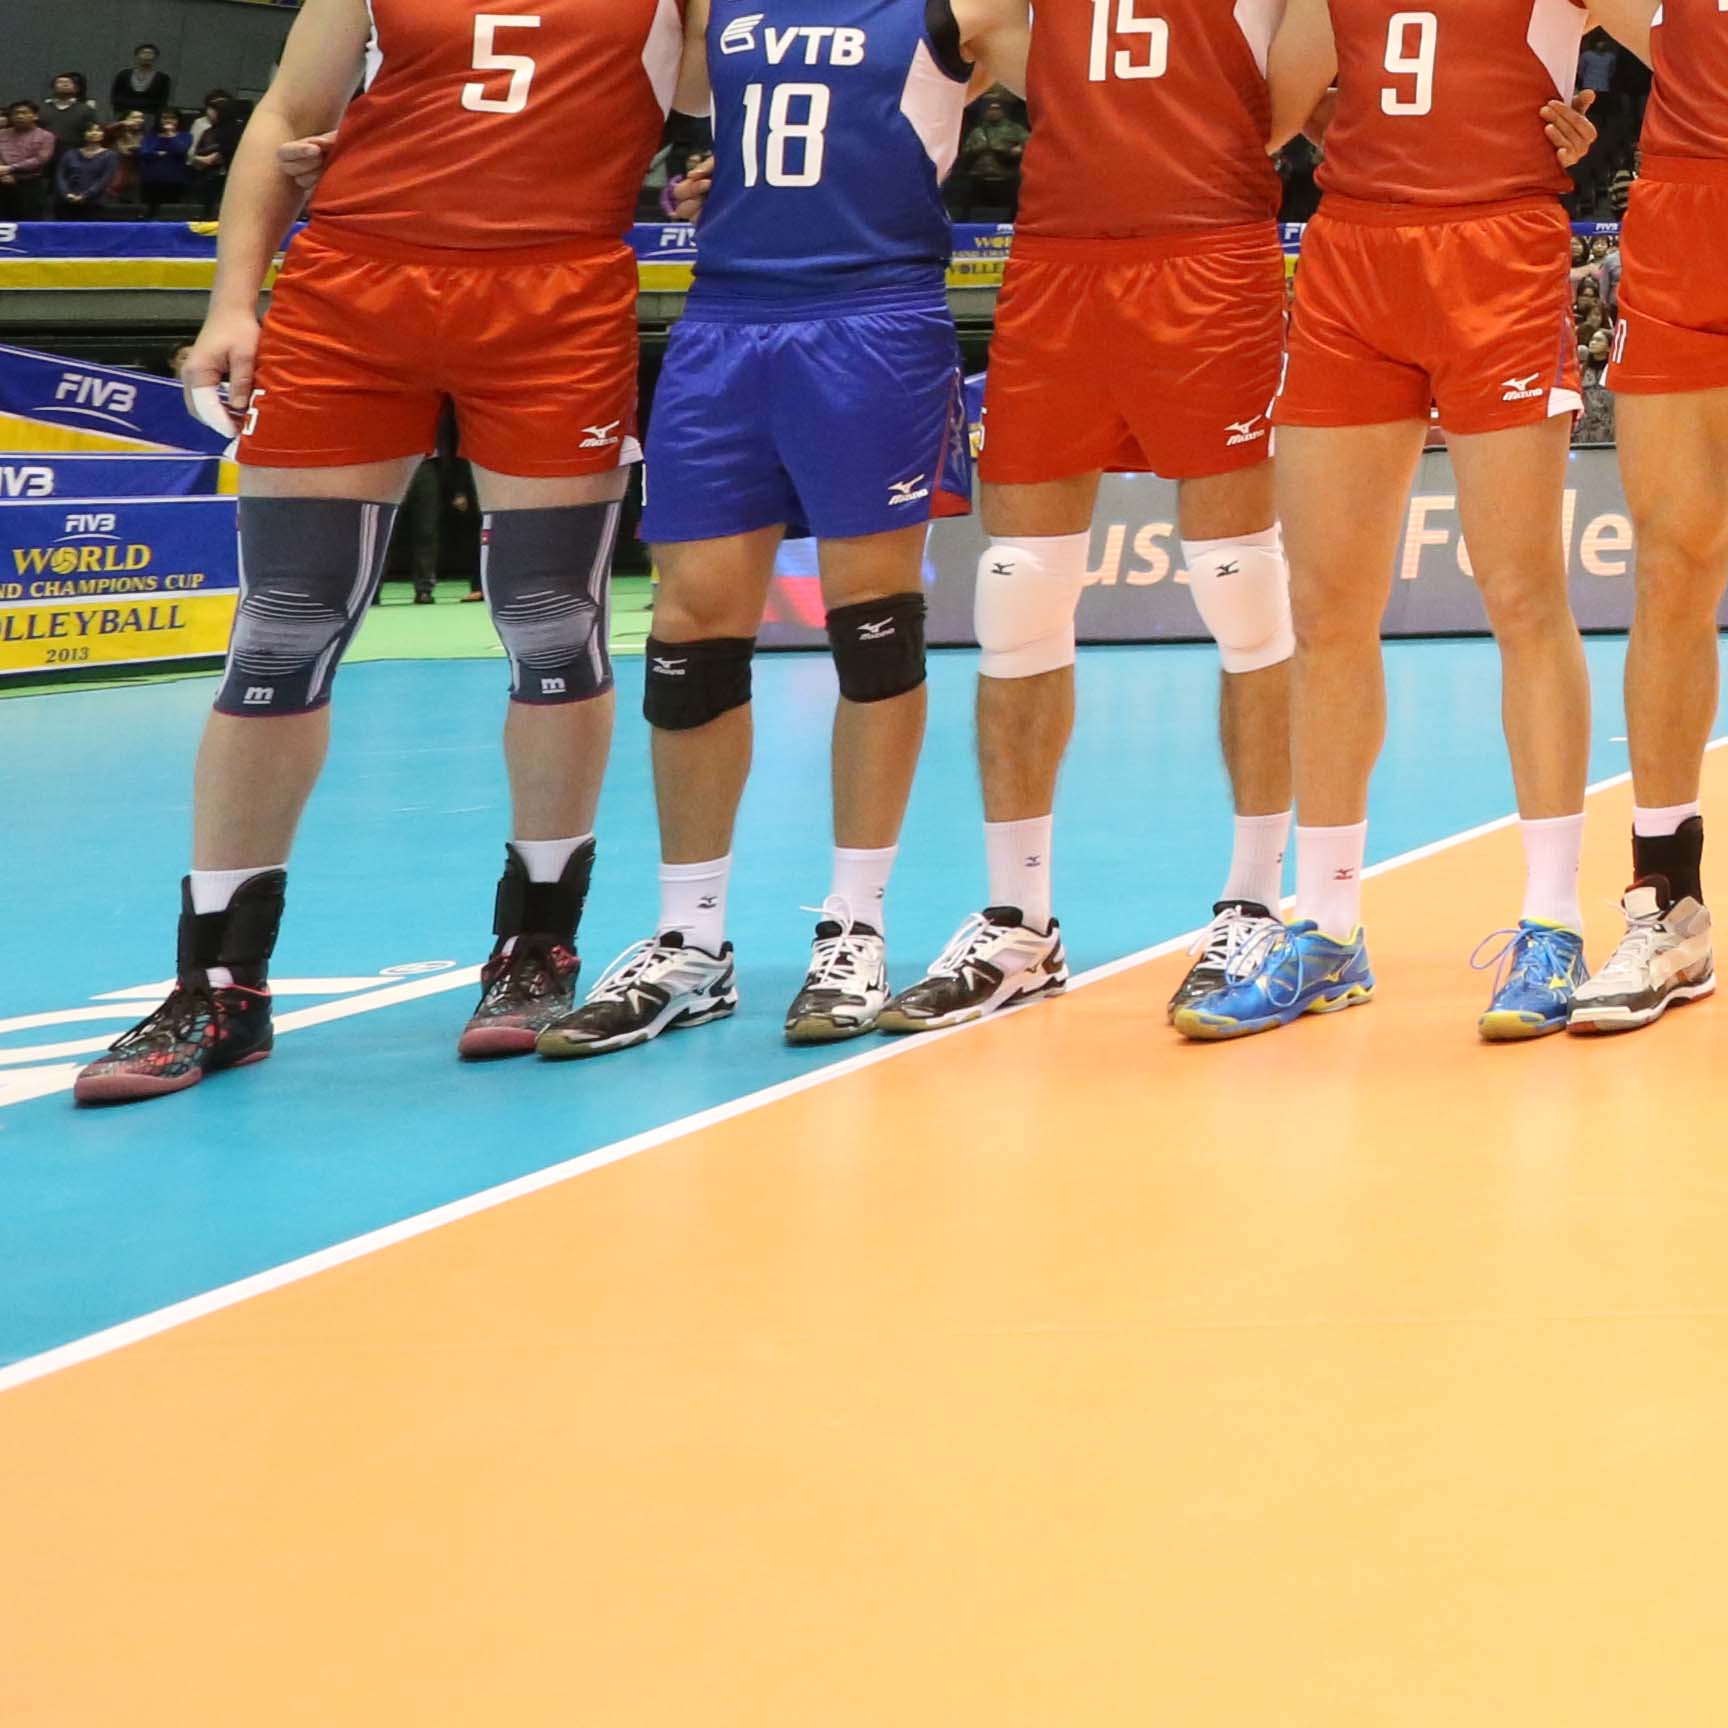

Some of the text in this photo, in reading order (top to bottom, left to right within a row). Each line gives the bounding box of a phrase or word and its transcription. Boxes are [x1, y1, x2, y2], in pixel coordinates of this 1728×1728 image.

[461, 14, 541, 113] 5
[765, 27, 866, 66] VTB
[1380, 11, 1438, 116] 9
[742, 82, 831, 188] 18
[55, 373, 137, 413] FIVB
[65, 513, 117, 532] FIVB
[12, 544, 153, 575] WORLD
[30, 575, 158, 598] CHAMPIONS
[165, 573, 206, 589] CUP
[0, 604, 187, 641] LLEYBALL
[46, 647, 91, 664] 2013
